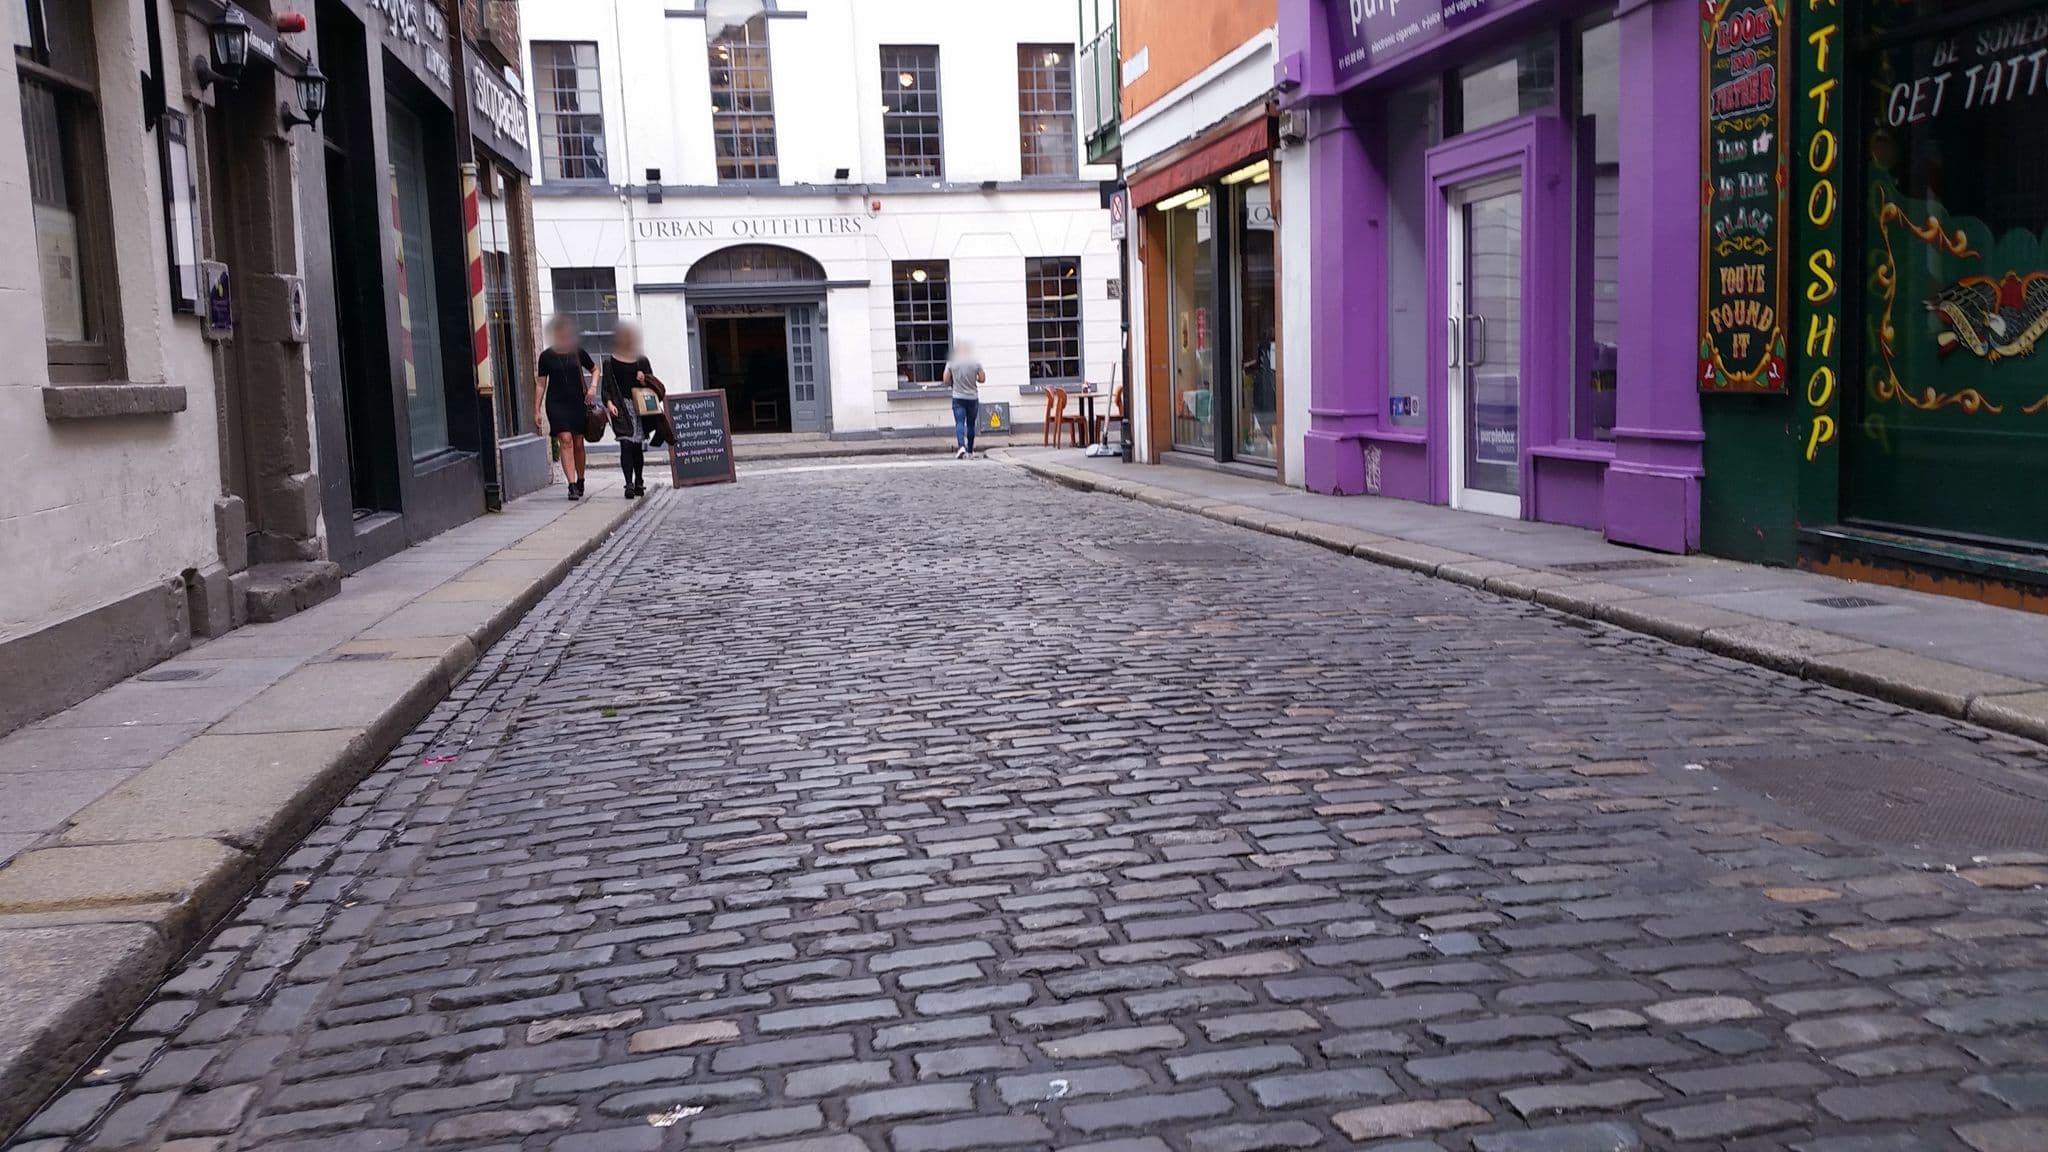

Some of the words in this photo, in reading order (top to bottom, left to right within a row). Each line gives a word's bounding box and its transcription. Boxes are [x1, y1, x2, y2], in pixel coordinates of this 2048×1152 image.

[1717, 9, 1772, 53] LOOK
[1932, 39, 1960, 67] BE
[1888, 72, 1952, 127] GET
[1964, 48, 2048, 110] TATT
[1808, 0, 1838, 227] TTOO
[638, 219, 714, 238] URBAN
[732, 216, 862, 238] OUTFITTERS
[1719, 263, 1765, 295] YOU'VE
[1710, 300, 1774, 334] FOUND
[1732, 333, 1750, 358] IT
[1806, 249, 1836, 461] SHOP
